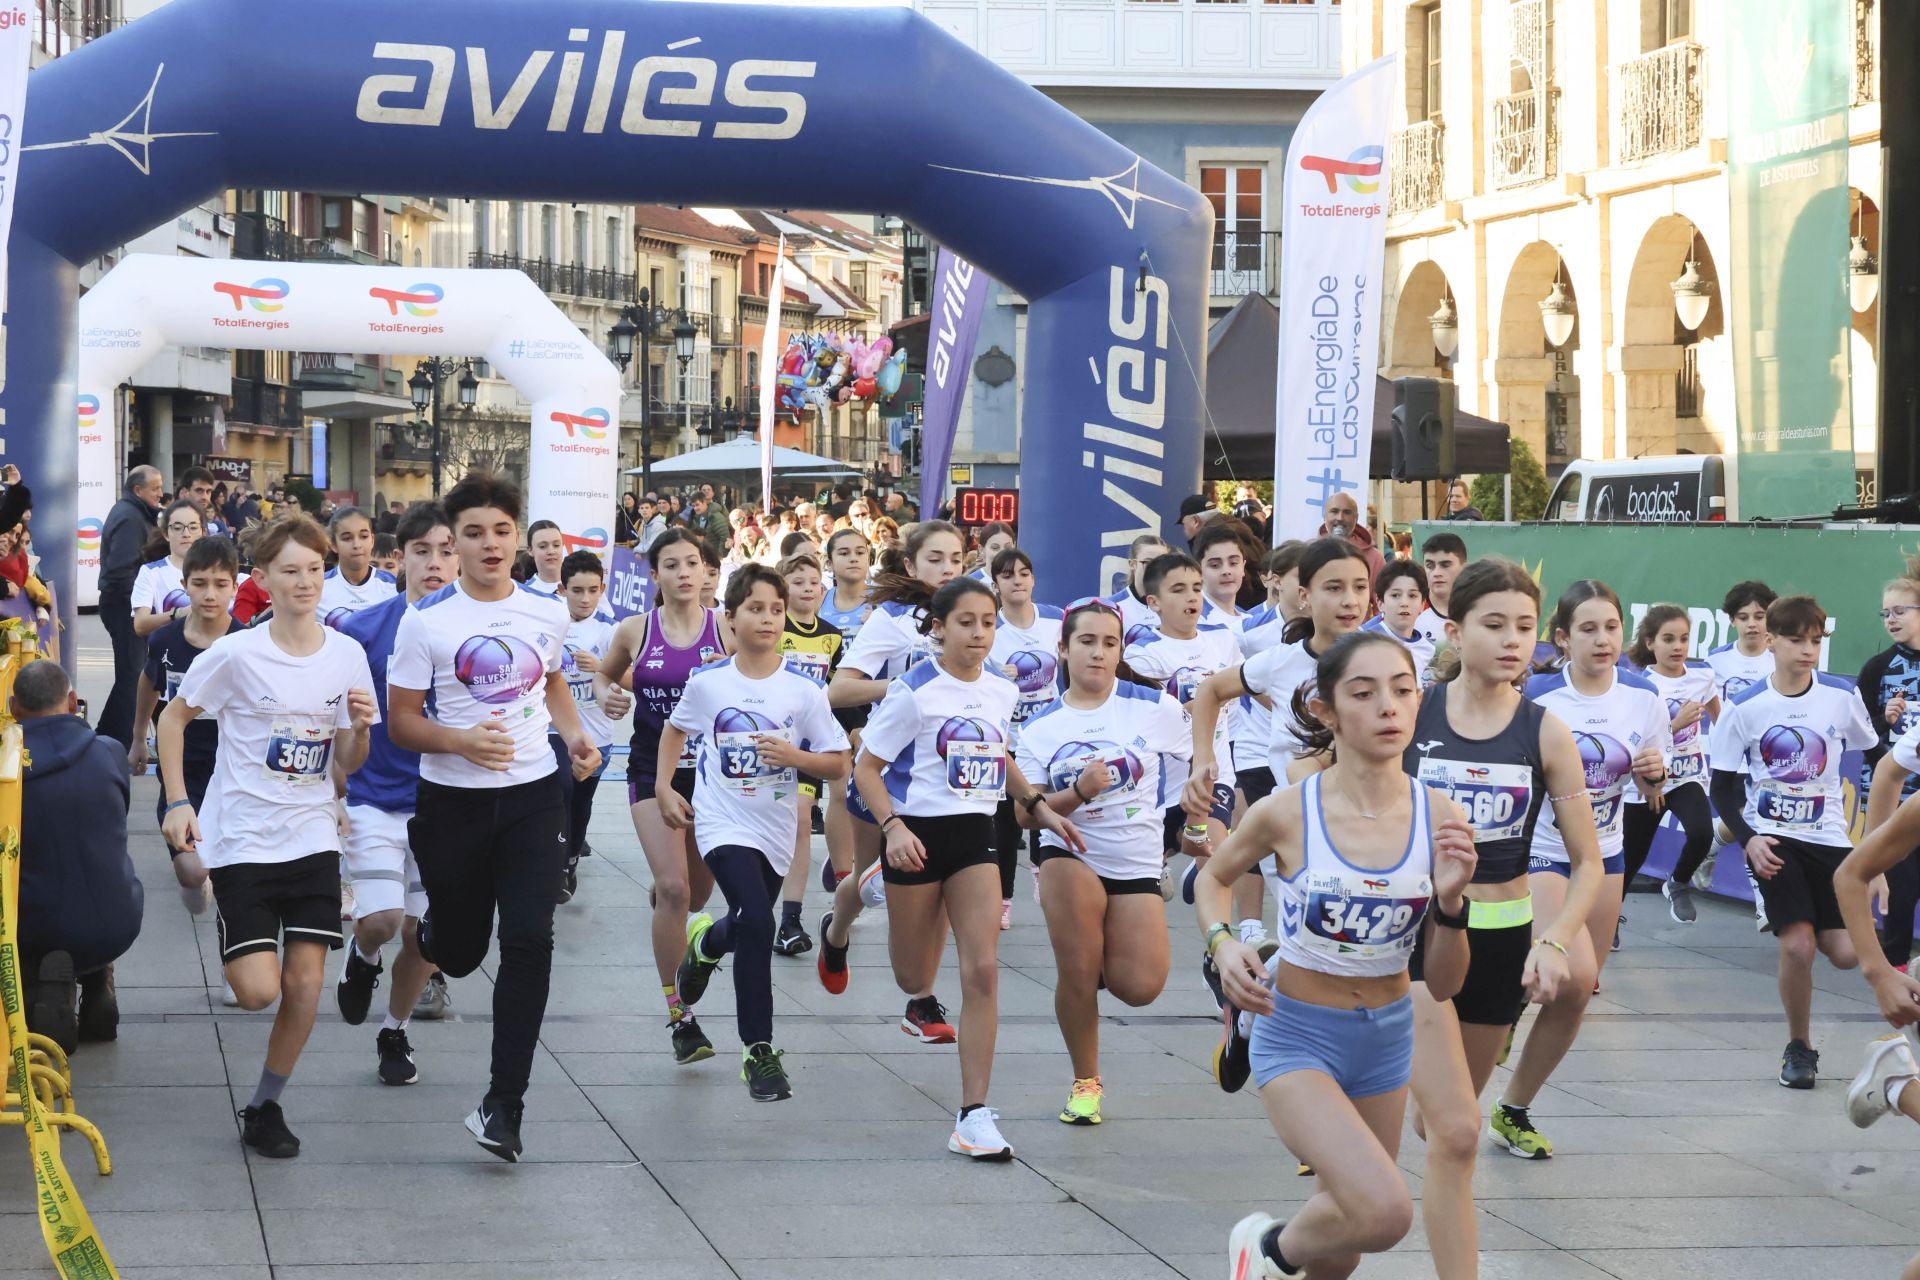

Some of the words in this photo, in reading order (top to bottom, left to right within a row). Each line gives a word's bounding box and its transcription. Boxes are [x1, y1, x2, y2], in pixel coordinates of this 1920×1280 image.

[356, 28, 817, 140] avilés
[213, 317, 290, 330] TotalEnergies
[369, 322, 444, 334] TotalEnergies
[932, 252, 975, 389] avilé
[551, 444, 610, 456] TotalEnergies
[473, 672, 522, 685] SILVESTRE
[498, 664, 517, 673] SAN
[671, 687, 684, 697] D
[278, 743, 326, 770] 3601
[958, 760, 999, 785] 3021
[1442, 788, 1514, 824] 560
[1768, 796, 1814, 821] 3581
[1321, 901, 1413, 939] 3429
[39, 1151, 63, 1190] ASTURIAS
